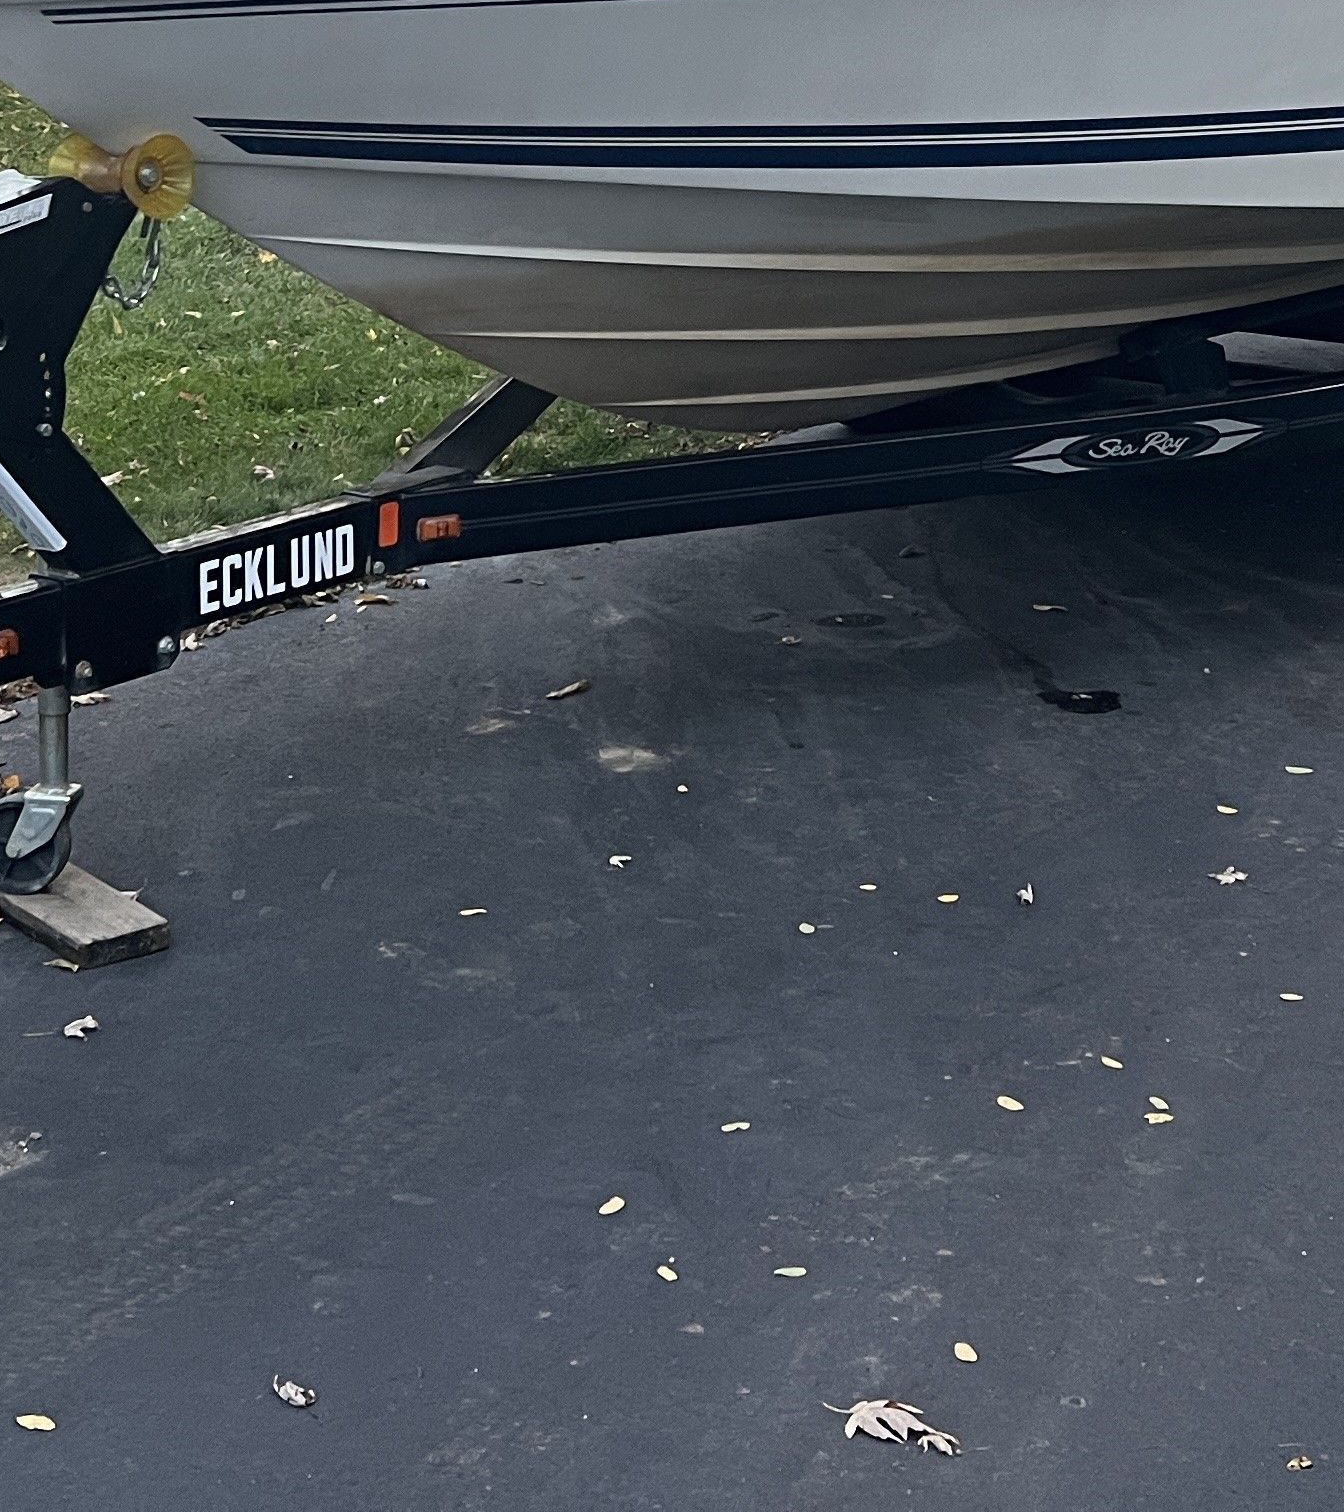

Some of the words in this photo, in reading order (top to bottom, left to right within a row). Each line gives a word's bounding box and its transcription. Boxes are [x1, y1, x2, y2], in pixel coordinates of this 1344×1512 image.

[1088, 438, 1139, 459] Sea
[1140, 431, 1190, 456] Ray
[199, 523, 355, 615] ECKLUND
